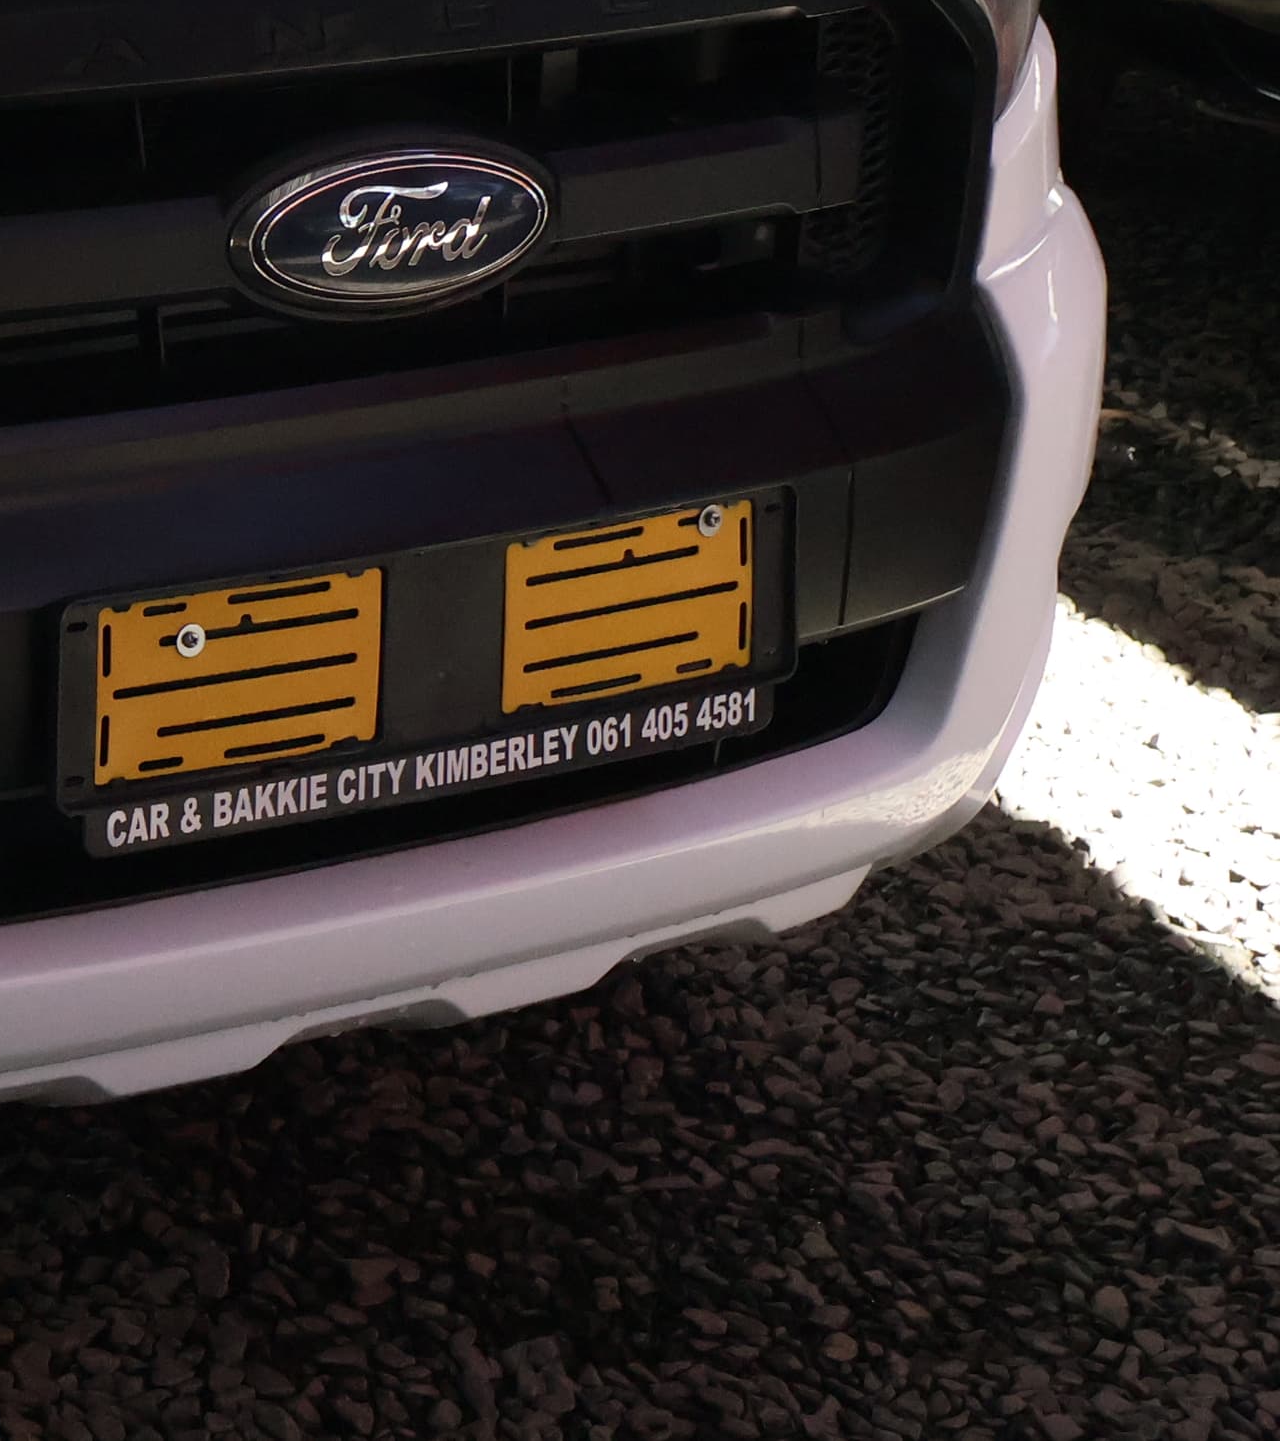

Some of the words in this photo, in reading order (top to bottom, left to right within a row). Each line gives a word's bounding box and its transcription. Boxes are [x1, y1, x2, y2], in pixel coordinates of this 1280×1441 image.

[321, 181, 491, 277] Ford
[106, 802, 170, 848] CAR
[180, 797, 202, 834] &
[213, 773, 328, 828] BAKKIE
[337, 759, 407, 805] CITY
[415, 725, 579, 791] KIMBERLEY
[586, 712, 632, 757] 061
[641, 701, 689, 743] 405
[696, 687, 757, 731] 4581
